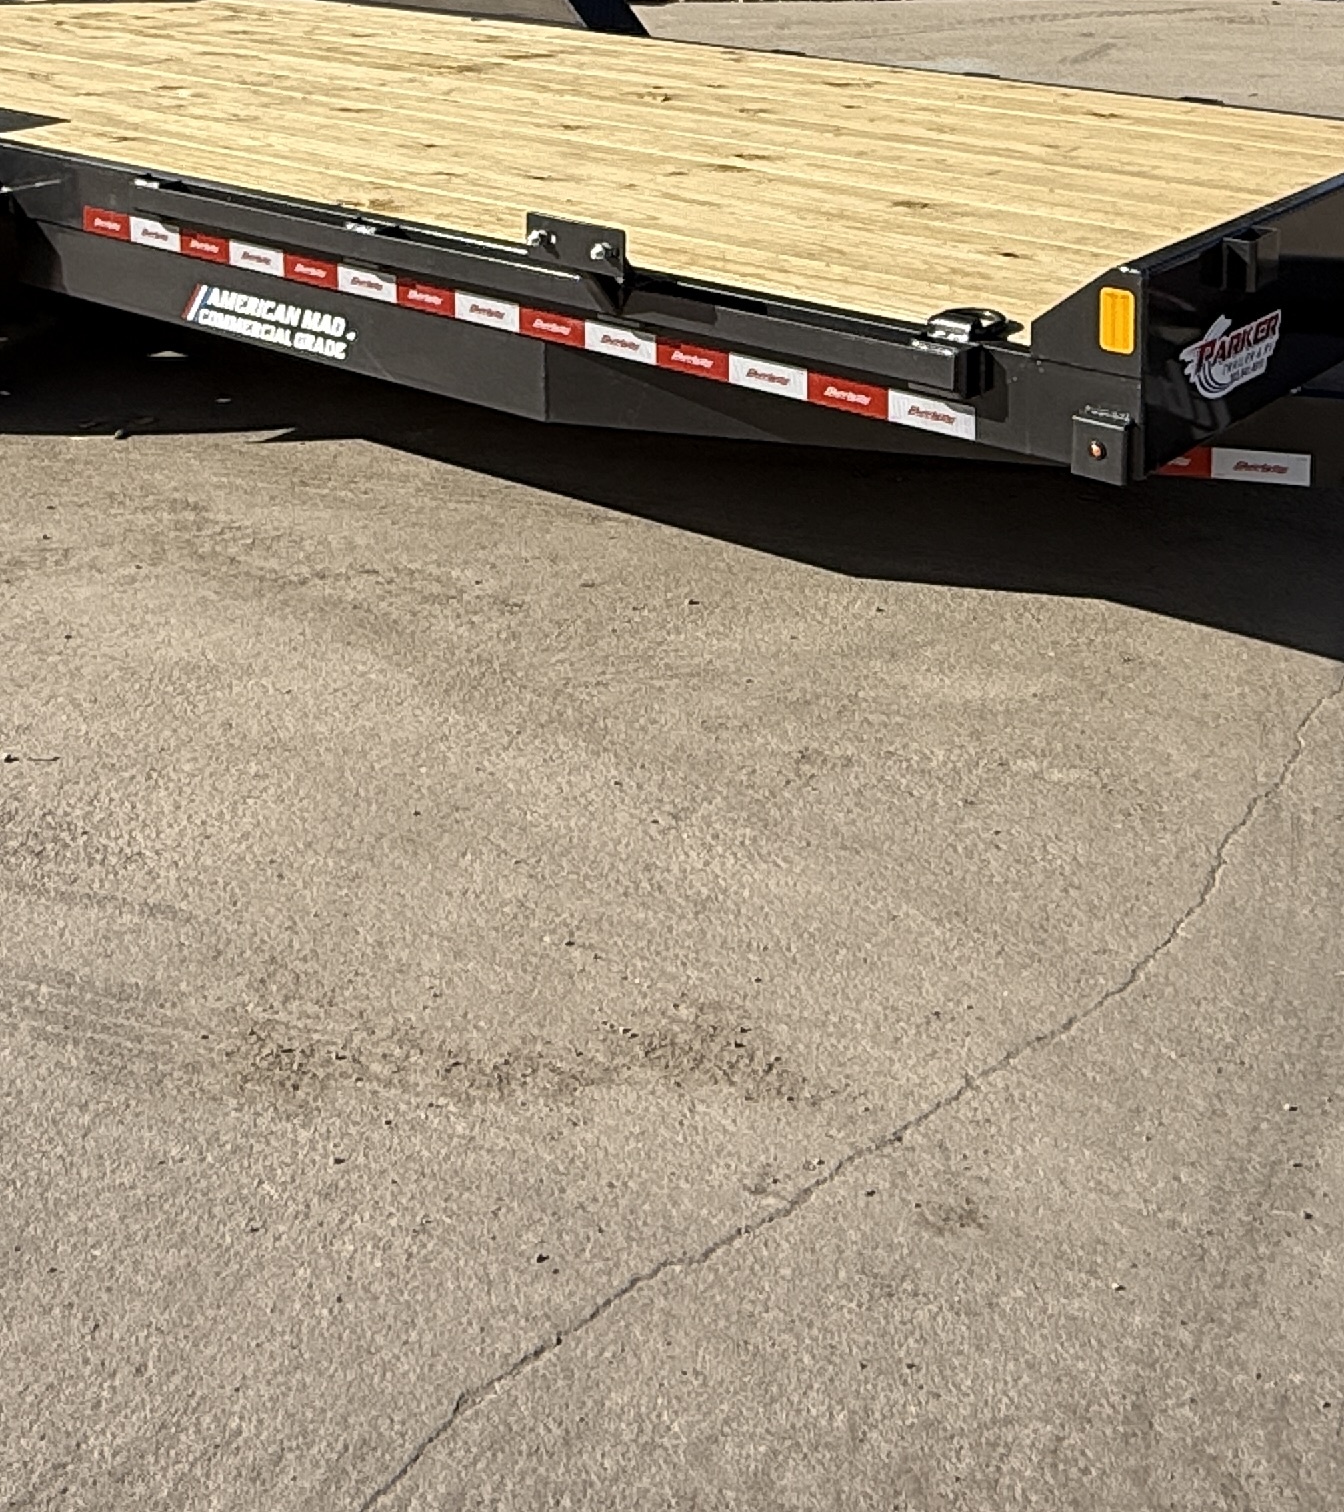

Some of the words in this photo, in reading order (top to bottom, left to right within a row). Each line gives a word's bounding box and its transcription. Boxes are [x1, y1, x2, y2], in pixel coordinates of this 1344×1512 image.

[198, 308, 292, 348] COMMERCIAL
[293, 331, 348, 361] GRADE
[207, 287, 301, 328] AMERICAN
[300, 308, 357, 341] MAD
[1196, 310, 1280, 373] PARKER
